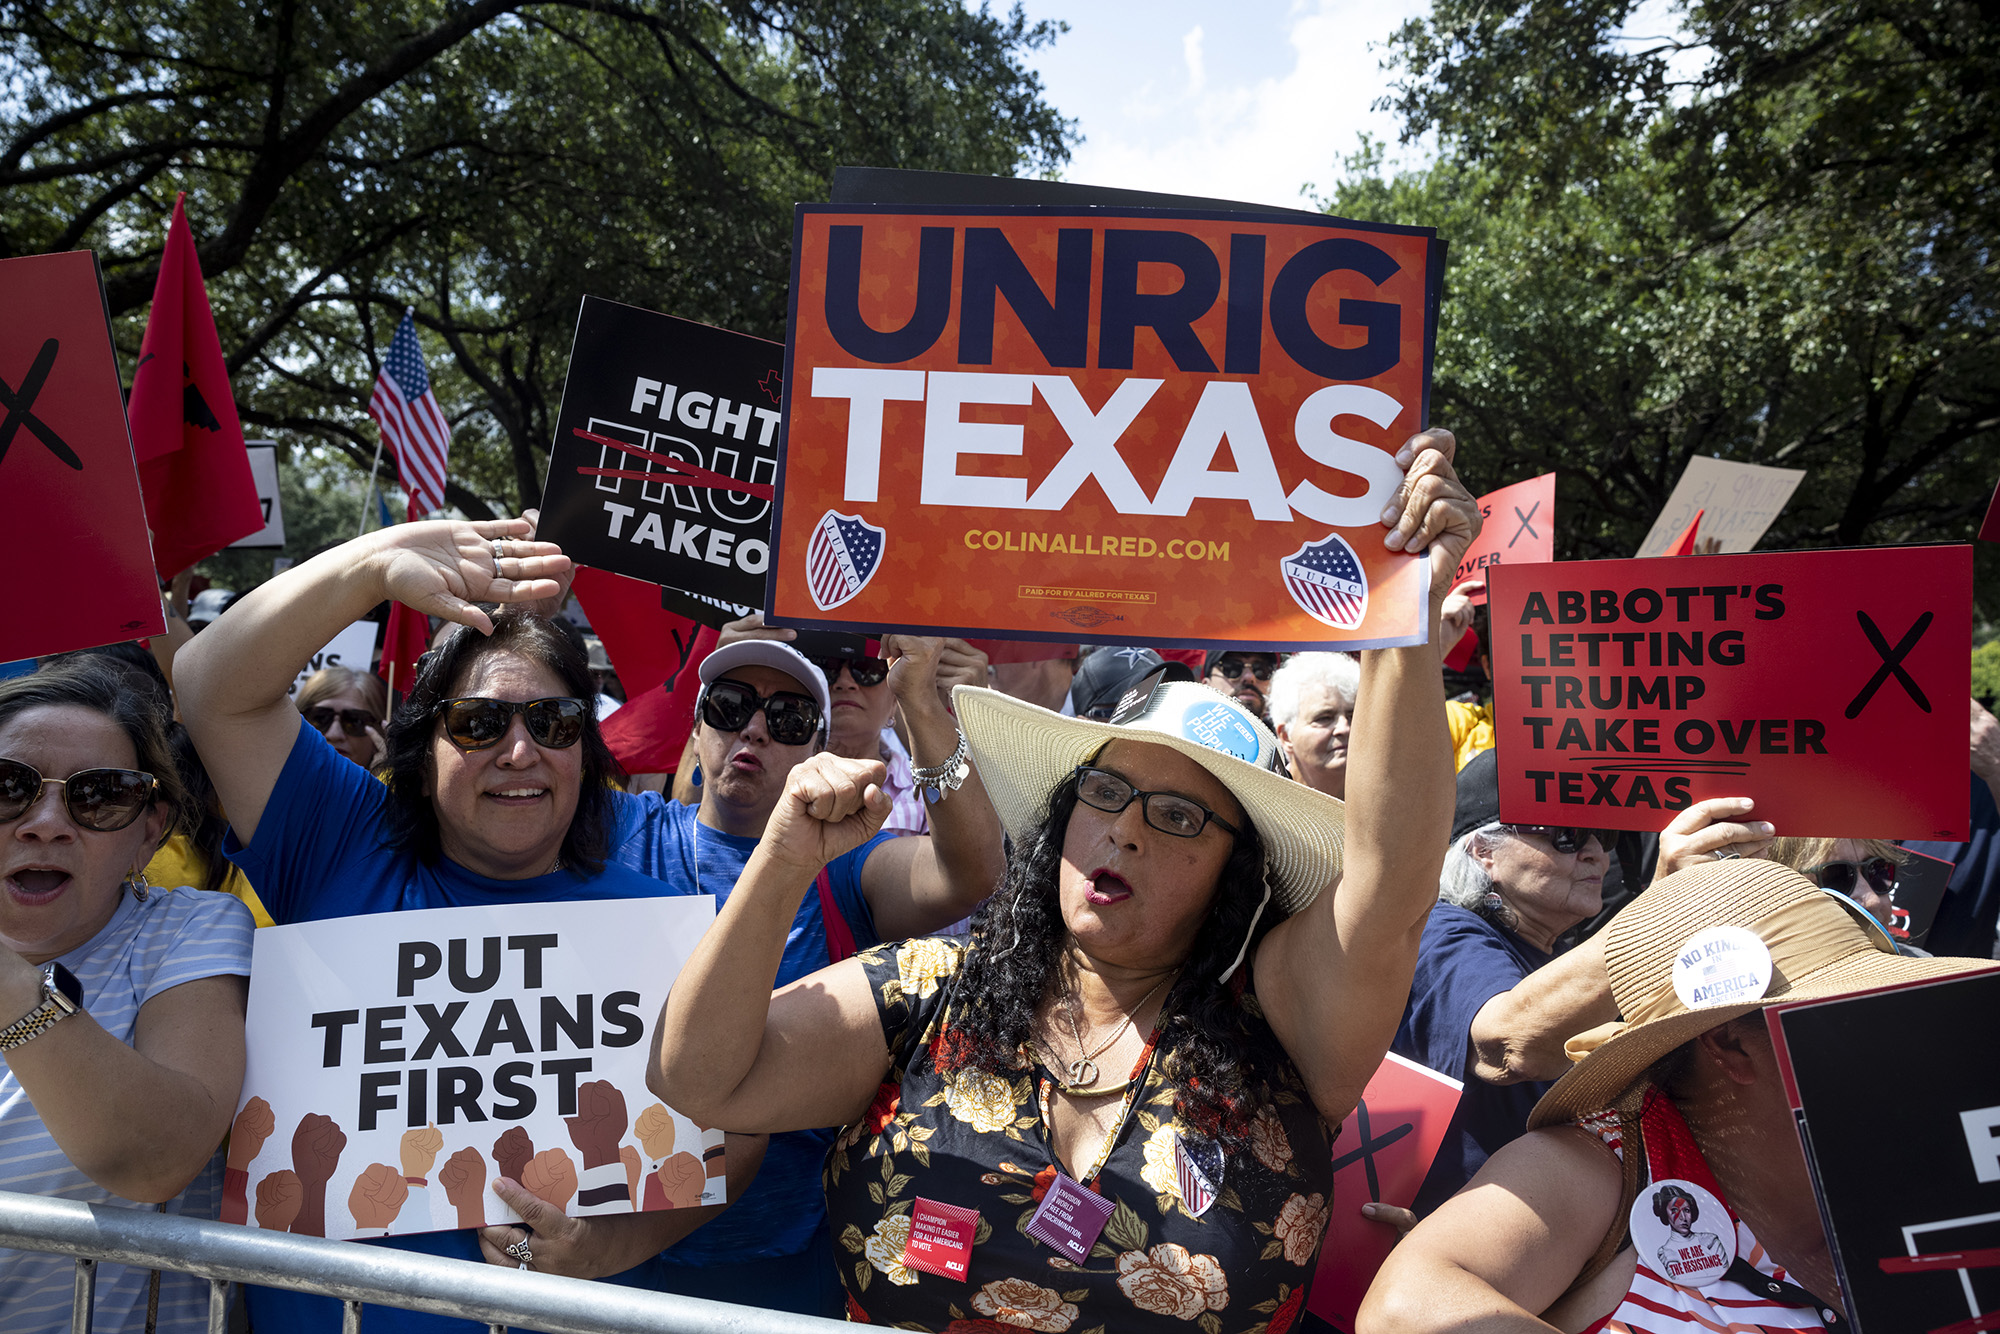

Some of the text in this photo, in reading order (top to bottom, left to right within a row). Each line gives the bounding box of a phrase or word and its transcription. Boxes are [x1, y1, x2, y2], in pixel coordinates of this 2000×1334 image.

[824, 225, 1402, 381] UNRIG
[630, 376, 782, 448] FIGHT
[811, 366, 1405, 527] TEXAS
[603, 500, 771, 575] TAKEO
[964, 529, 1230, 562] COLINALLRED.COM
[826, 524, 857, 585] LULAC
[1455, 552, 1501, 580] OVER
[1293, 567, 1357, 593] LULAC
[1025, 588, 1044, 596] PAID
[1045, 589, 1061, 597] FOR
[1075, 591, 1105, 599] ALLRED
[1519, 584, 1786, 625] ABBOTT'S
[1521, 630, 1746, 667] LETTING
[1521, 675, 1706, 710] TRUMP
[1200, 709, 1227, 735] THE
[1211, 704, 1236, 725] WE
[1235, 723, 1254, 742] ACLU
[1523, 716, 1829, 755] TAKE OVER
[1525, 770, 1693, 812] TEXAS
[396, 933, 558, 998] PUT
[1680, 949, 1703, 969] NO
[1712, 954, 1722, 964] IN
[1693, 972, 1760, 1003] AMERICA
[311, 990, 644, 1068] TEXANS
[357, 1056, 593, 1132] FIRST
[1055, 1197, 1074, 1212] WORLD
[1058, 1188, 1082, 1206] ENVISION
[919, 1213, 948, 1226] CHAMPION
[1042, 1210, 1082, 1240] DISCRIMINATION.
[1047, 1202, 1074, 1223] FREE FROM
[913, 1230, 964, 1250] FOR ALL AMERICANS
[915, 1221, 960, 1240] MAKING IT EASIER
[911, 1239, 918, 1249] TO
[1066, 1239, 1086, 1254] ACLU
[1677, 1244, 1705, 1261] WE ARE
[945, 1260, 964, 1272] ACLU
[1669, 1254, 1723, 1277] THE RESISTANCE
